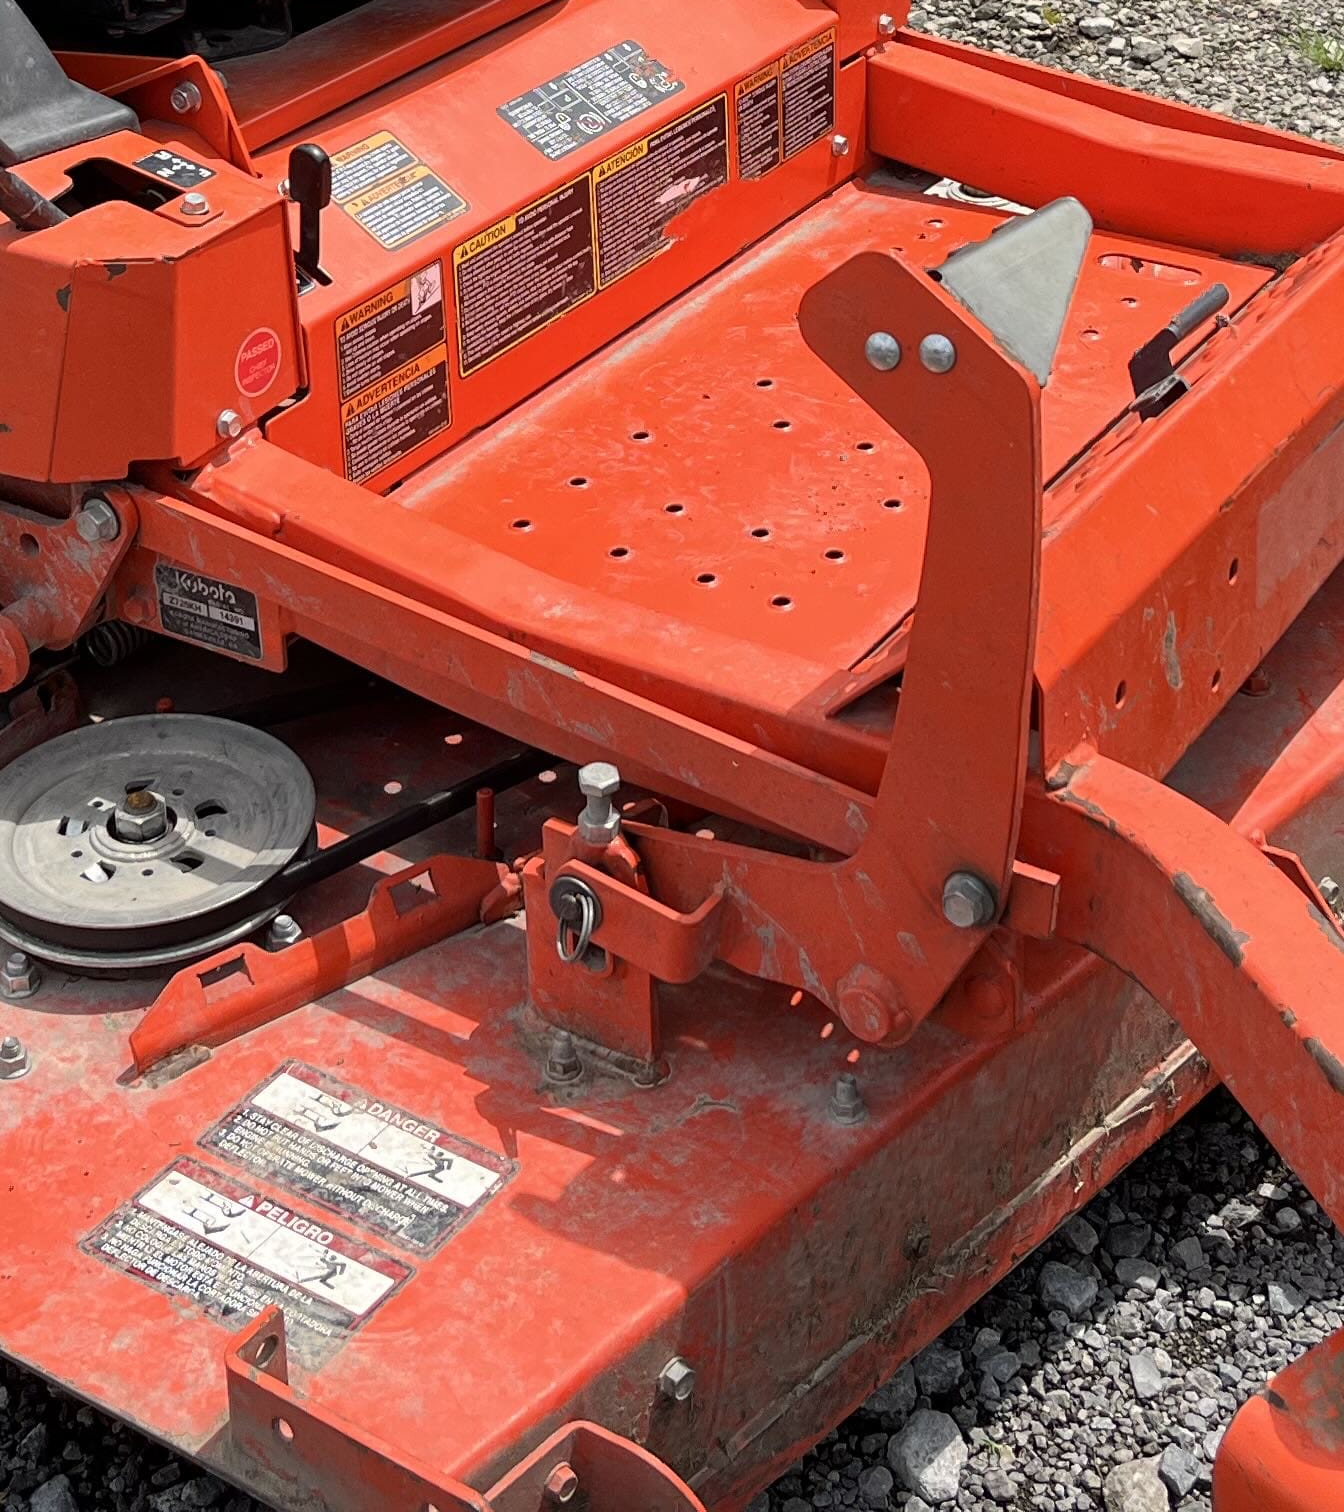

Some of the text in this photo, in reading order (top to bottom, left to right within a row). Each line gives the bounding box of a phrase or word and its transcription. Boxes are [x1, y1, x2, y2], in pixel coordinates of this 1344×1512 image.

[468, 223, 506, 254] CAUTION
[349, 290, 393, 325] WARNING
[240, 338, 275, 363] PASSED
[356, 361, 420, 408] ADVERTENCIA
[175, 570, 237, 604] Kubota
[232, 1125, 266, 1144] ENGINE
[364, 1102, 442, 1143] DANGER
[225, 1132, 242, 1143] DO
[292, 1165, 328, 1186] MOWER
[240, 1118, 256, 1129] DO
[252, 1124, 275, 1138] NOT
[286, 1141, 319, 1160] HANDS
[315, 1155, 332, 1166] OR
[369, 1181, 405, 1202] MOWER
[401, 1196, 430, 1214] WHEN
[247, 1112, 273, 1127] STAY
[267, 1122, 299, 1140] CLEAR
[295, 1135, 312, 1146] OF
[390, 1181, 408, 1193] AT
[403, 1187, 425, 1201] ALL
[253, 1200, 336, 1245] PELIGRO
[98, 1242, 149, 1271] DEFLECTOR
[143, 1266, 160, 1276] DE
[140, 1254, 190, 1282] FUNCIONAR
[184, 1277, 201, 1288] LA
[151, 1250, 168, 1260] EL
[162, 1256, 194, 1275] MOTOR
[186, 1238, 225, 1260] ALEJADO
[233, 1261, 249, 1272] LA
